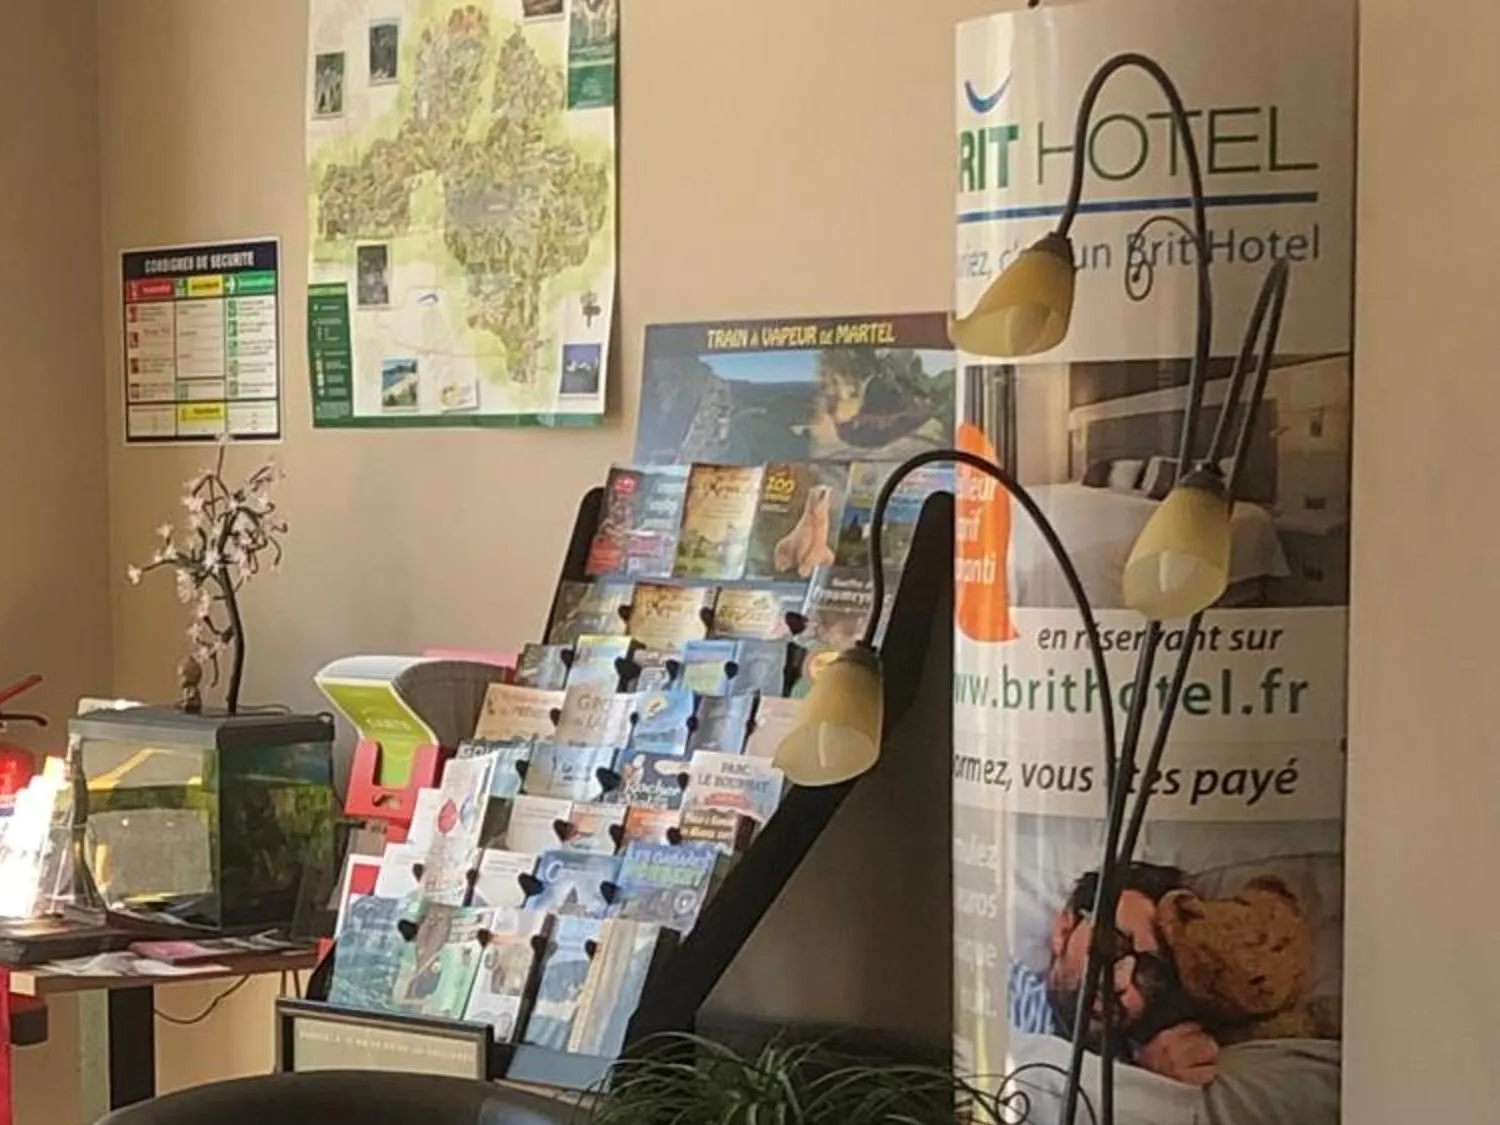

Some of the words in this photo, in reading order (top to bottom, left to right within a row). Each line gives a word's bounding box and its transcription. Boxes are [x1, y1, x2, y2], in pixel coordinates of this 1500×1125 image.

[1037, 106, 1319, 187] HOTEL
[1126, 231, 1194, 268] Brit
[1207, 223, 1320, 263] Hotel
[707, 328, 748, 349] TRAIN
[761, 325, 818, 347] VAPEUR
[835, 322, 896, 345] MARTEL
[1037, 628, 1067, 649] en
[1229, 627, 1284, 651] sur
[1021, 762, 1094, 793] vous
[1189, 757, 1299, 806] payé
